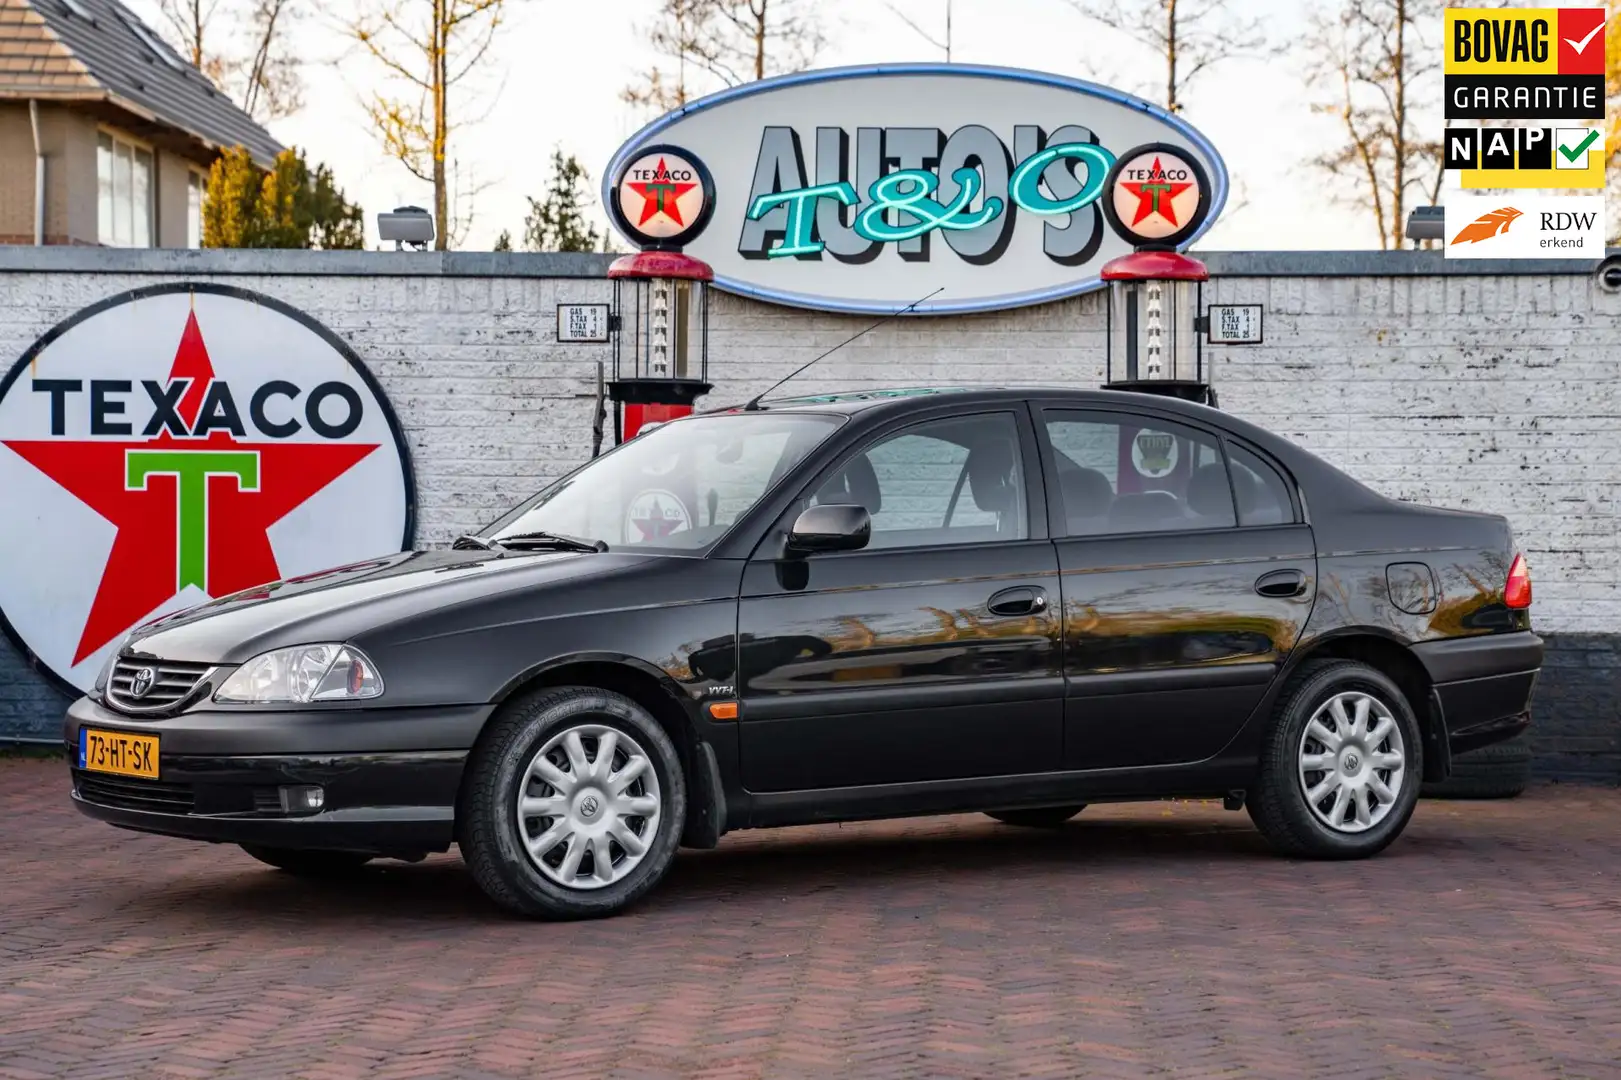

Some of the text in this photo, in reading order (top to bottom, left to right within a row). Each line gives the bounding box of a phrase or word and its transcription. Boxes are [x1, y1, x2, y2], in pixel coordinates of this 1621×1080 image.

[633, 169, 692, 181] TEXACO
[1127, 169, 1187, 181] TEXACO
[646, 184, 676, 211] T
[1141, 184, 1171, 211] T
[590, 308, 597, 316] 19
[1221, 308, 1250, 316] GAS 19
[590, 330, 597, 338] 25
[32, 378, 364, 440] TEXACO
[124, 449, 261, 593] T
[90, 736, 152, 772] 73-HT-SK
